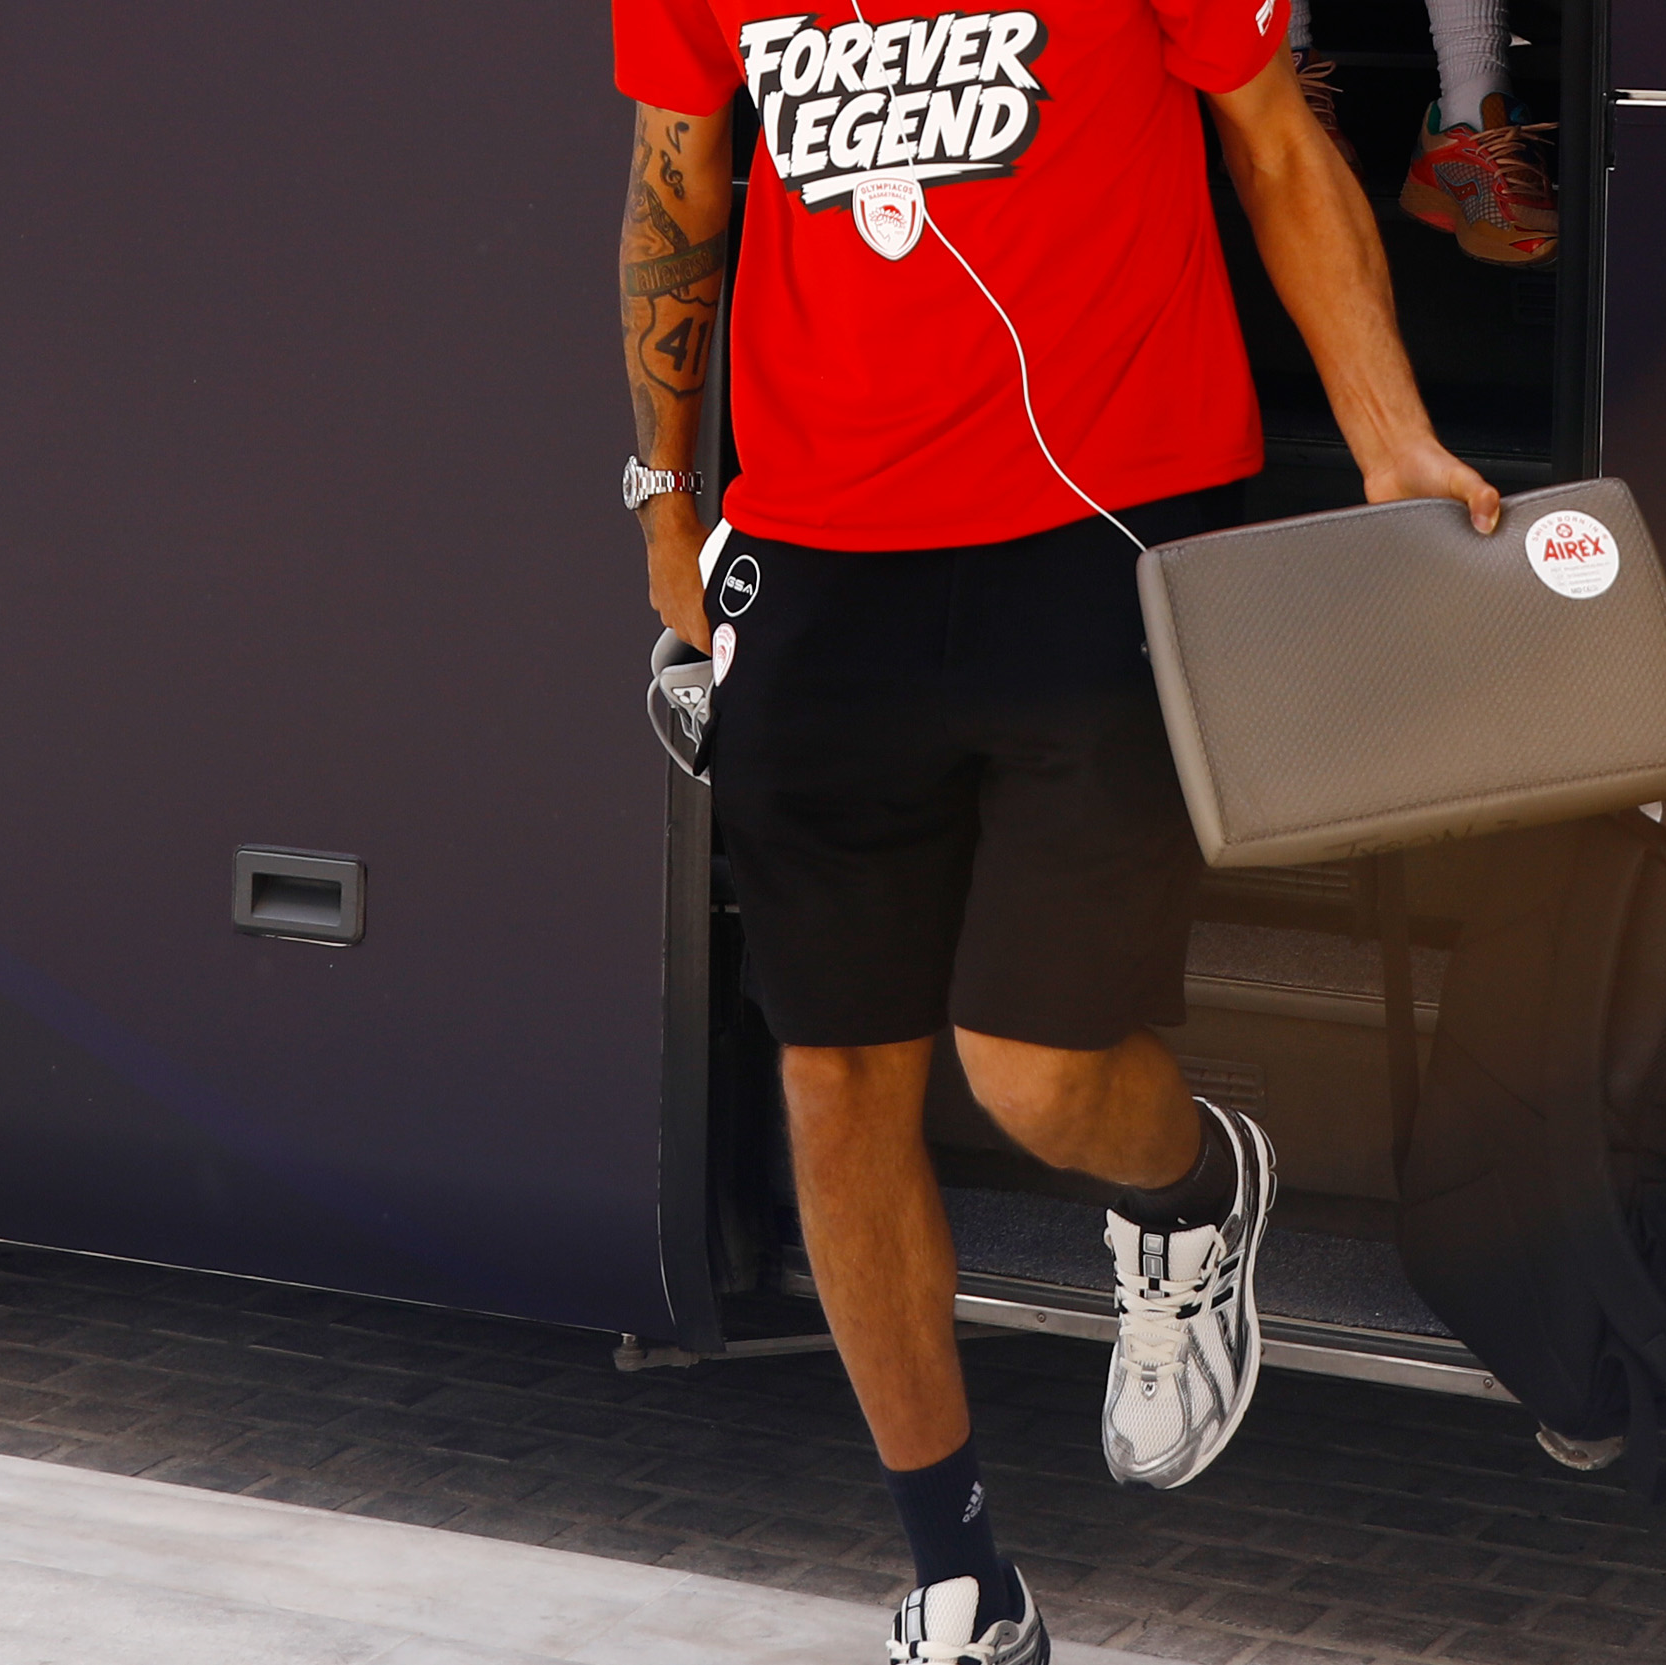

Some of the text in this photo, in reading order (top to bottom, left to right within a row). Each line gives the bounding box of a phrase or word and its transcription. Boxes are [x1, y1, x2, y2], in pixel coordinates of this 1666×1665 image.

[739, 10, 1040, 109] FOREVER
[763, 85, 1030, 179] LEGEND
[860, 183, 913, 195] OLYMPIACOS
[654, 317, 710, 376] 41
[1543, 533, 1605, 563] AIREX
